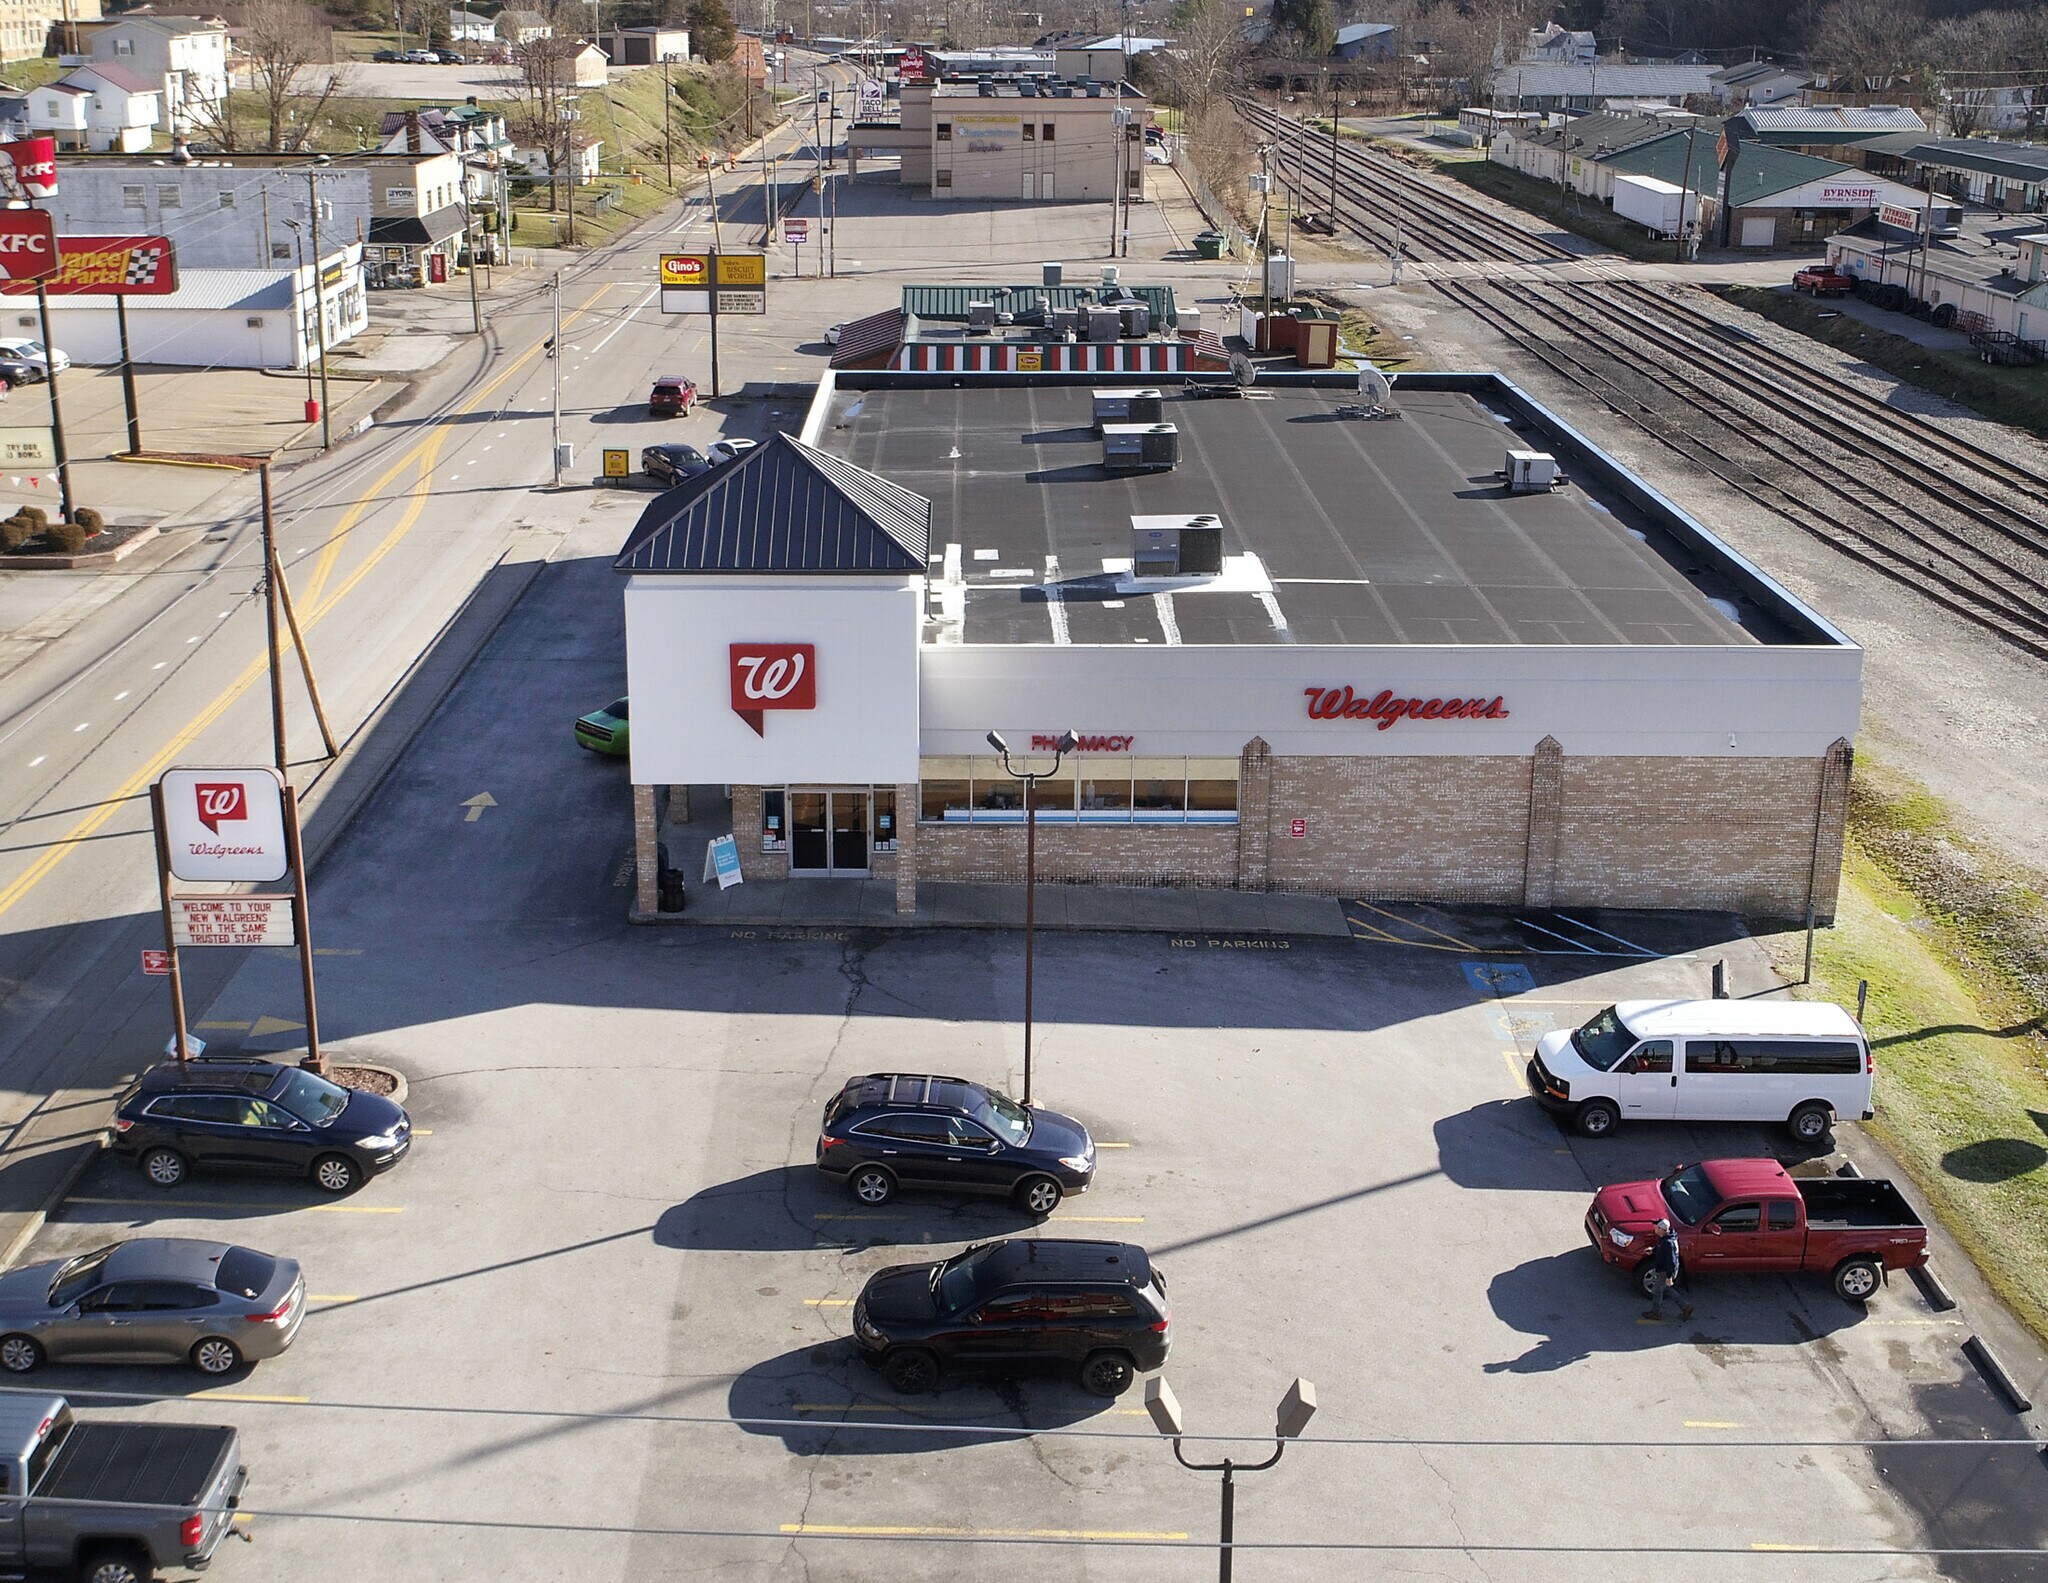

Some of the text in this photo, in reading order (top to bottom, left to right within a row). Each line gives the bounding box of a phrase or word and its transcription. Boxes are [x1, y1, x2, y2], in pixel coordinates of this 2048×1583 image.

[21, 161, 54, 177] KFC
[1884, 207, 1912, 220] BYRNSIDE
[1881, 214, 1914, 229] HARDWARE
[668, 260, 700, 273] Gino's
[728, 272, 755, 280] WORLD
[1304, 686, 1510, 731] Walgreens
[189, 842, 264, 859] Walgreens
[182, 902, 272, 913] WELCOME TO YOUR
[190, 913, 268, 923] NEW WALGREENS
[188, 924, 267, 933] WITH THE SAME
[189, 934, 263, 944] TRUSTED STAFF
[730, 931, 756, 939] NO
[1171, 939, 1290, 949] NO PARKING
